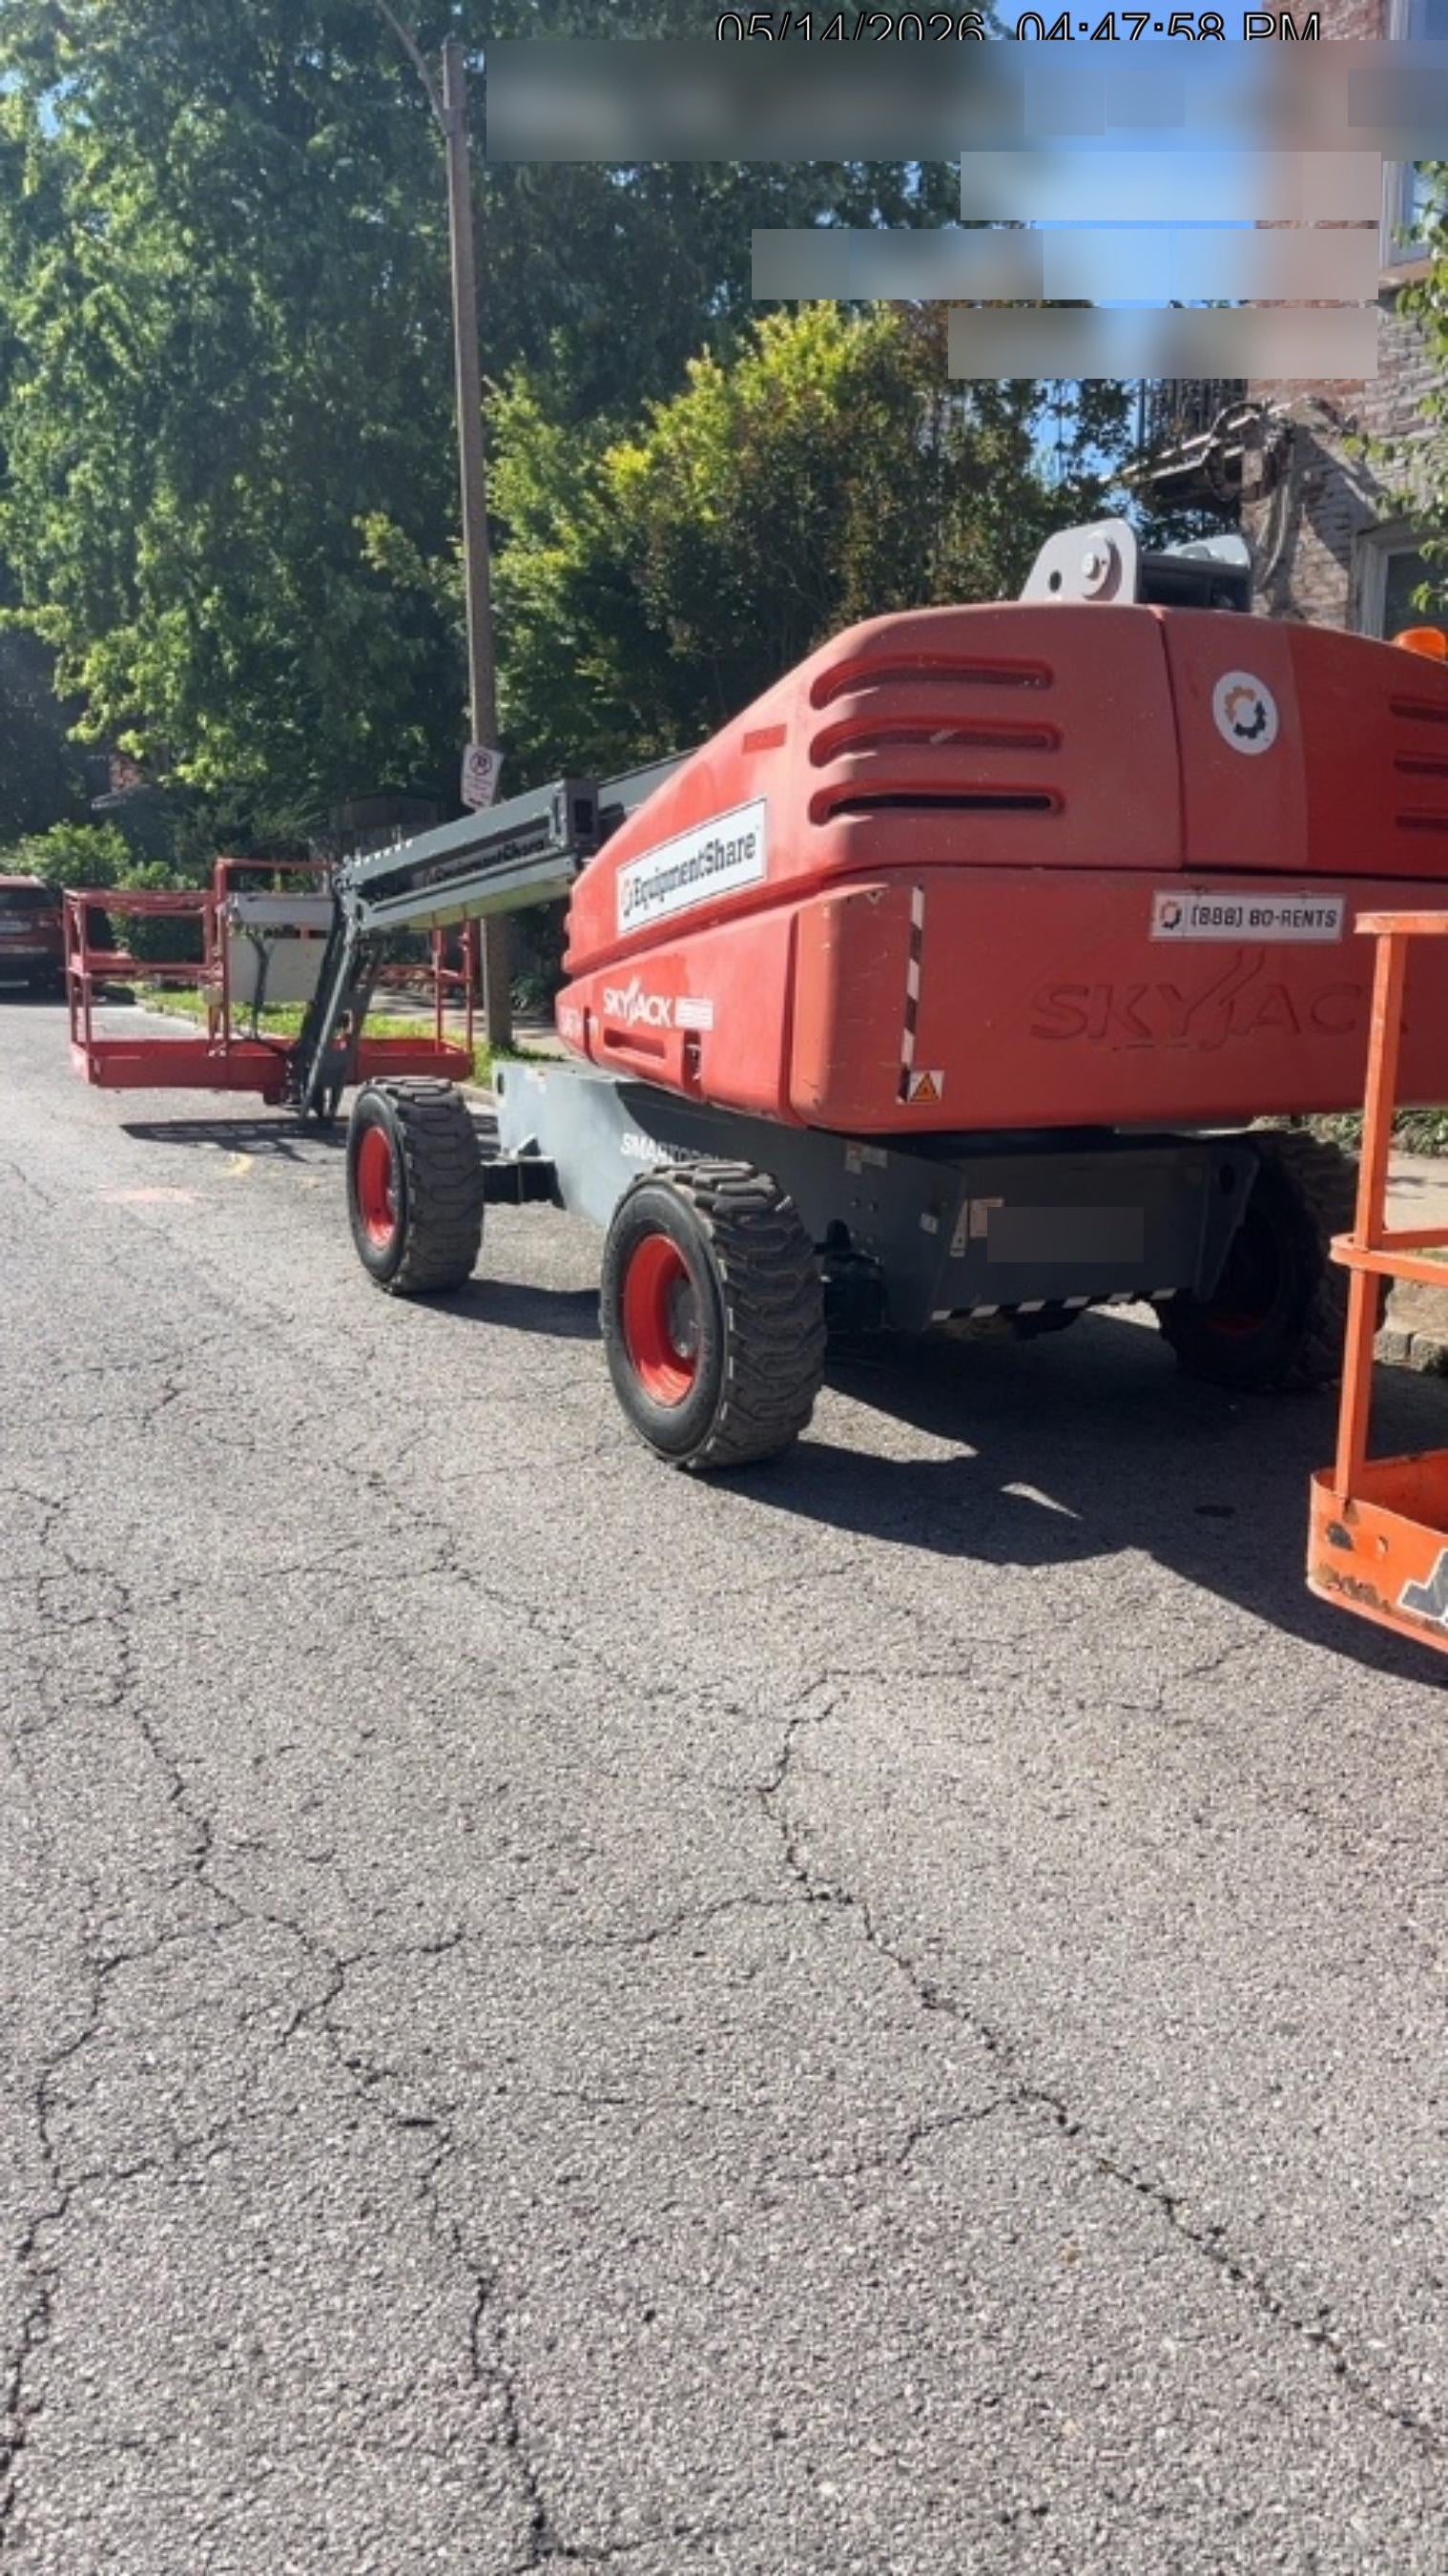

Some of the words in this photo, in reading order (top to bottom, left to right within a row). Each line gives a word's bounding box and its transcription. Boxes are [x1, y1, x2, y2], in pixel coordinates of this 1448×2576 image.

[633, 832, 756, 910] EquipmentShare
[603, 975, 672, 1028] SKYJACK
[1029, 946, 1409, 1051] SKYJAC
